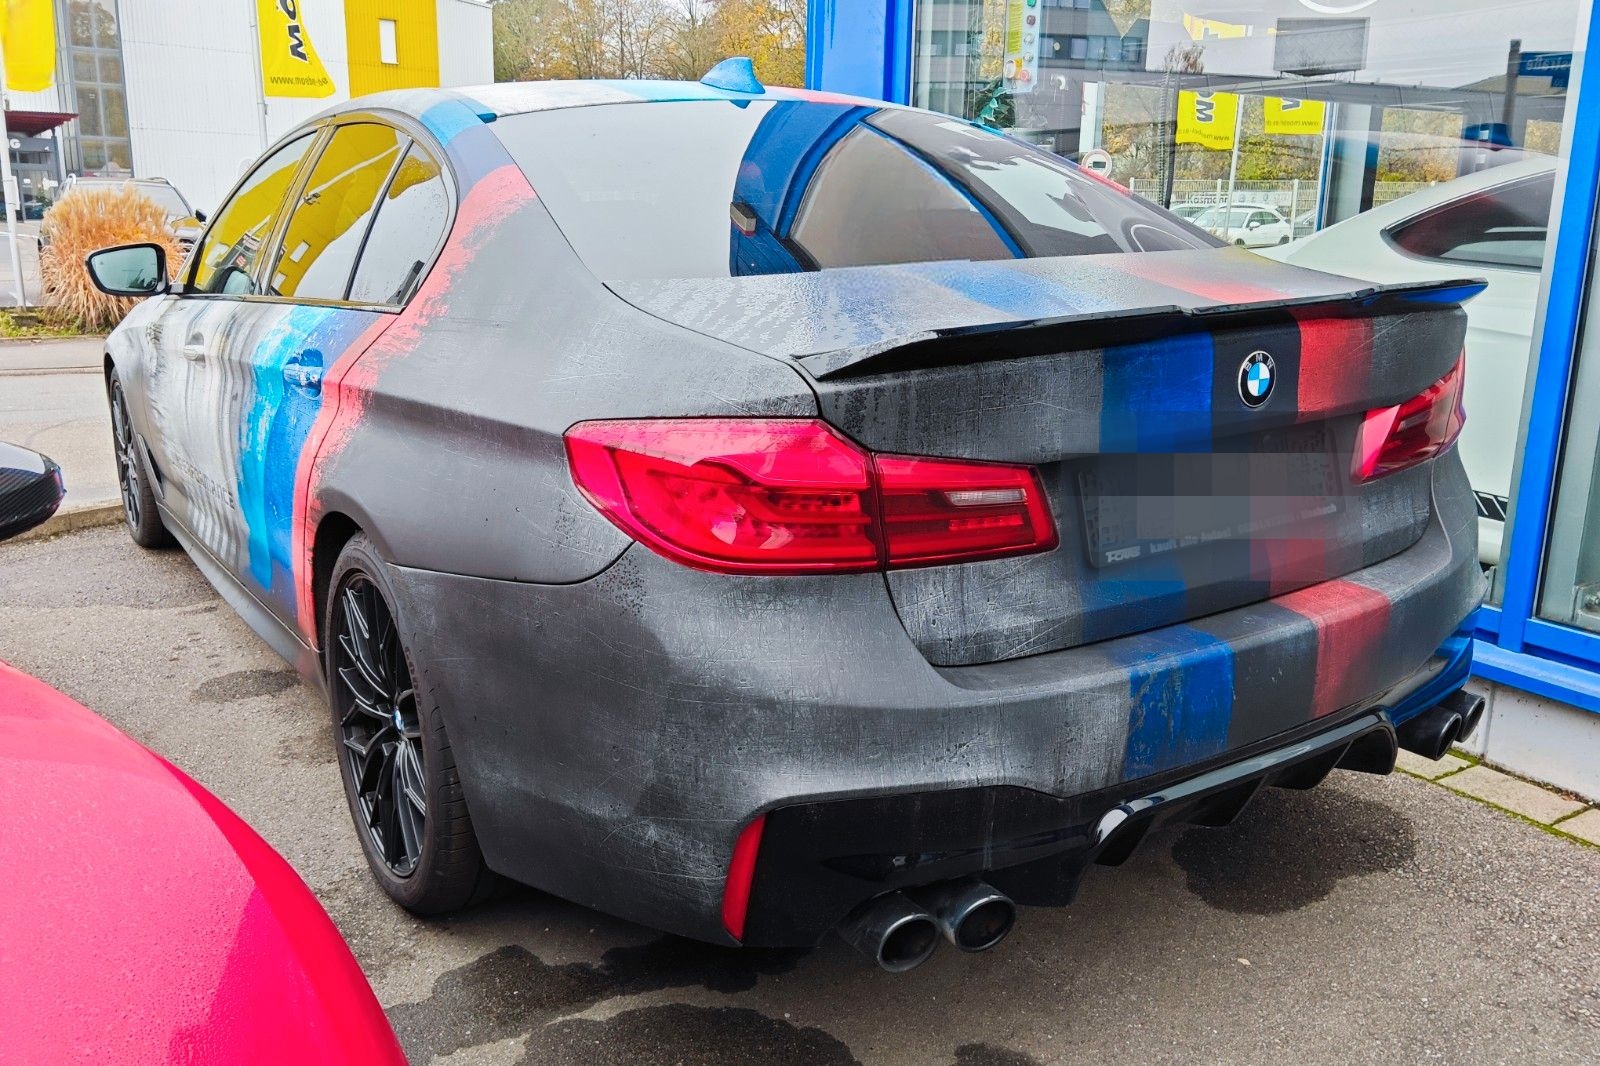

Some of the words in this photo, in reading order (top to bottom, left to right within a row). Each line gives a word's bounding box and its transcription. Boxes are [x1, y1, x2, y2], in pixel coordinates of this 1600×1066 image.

[1244, 352, 1274, 371] BMW
[1150, 538, 1178, 554] kauft
[1179, 534, 1199, 548] alle
